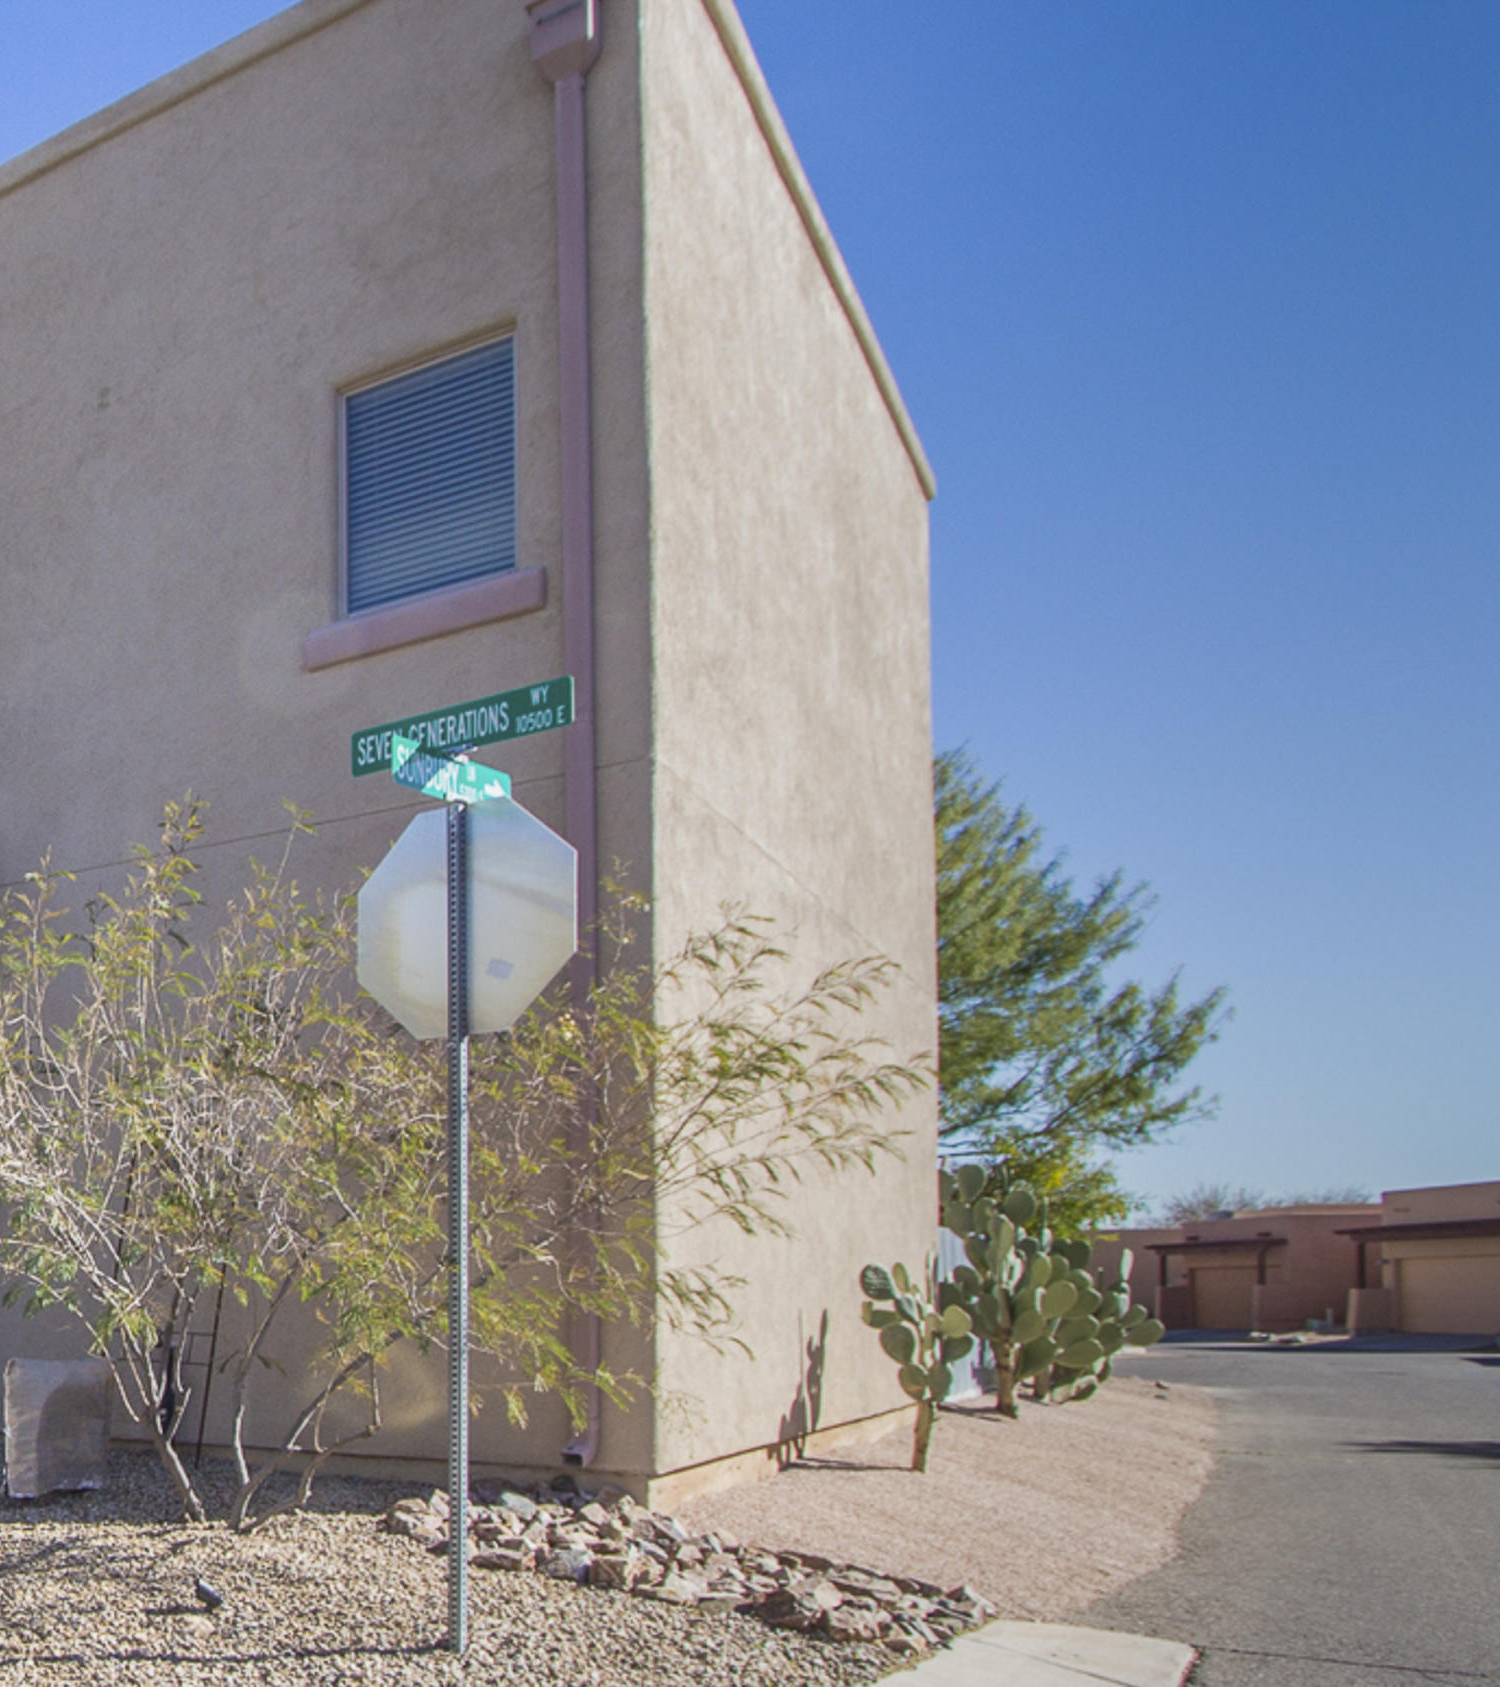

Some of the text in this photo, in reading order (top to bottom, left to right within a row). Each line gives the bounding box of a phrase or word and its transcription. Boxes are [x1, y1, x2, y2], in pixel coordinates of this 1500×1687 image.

[408, 701, 510, 748] GENERATIONS
[530, 685, 549, 706] WY
[516, 705, 565, 734] 10500 E
